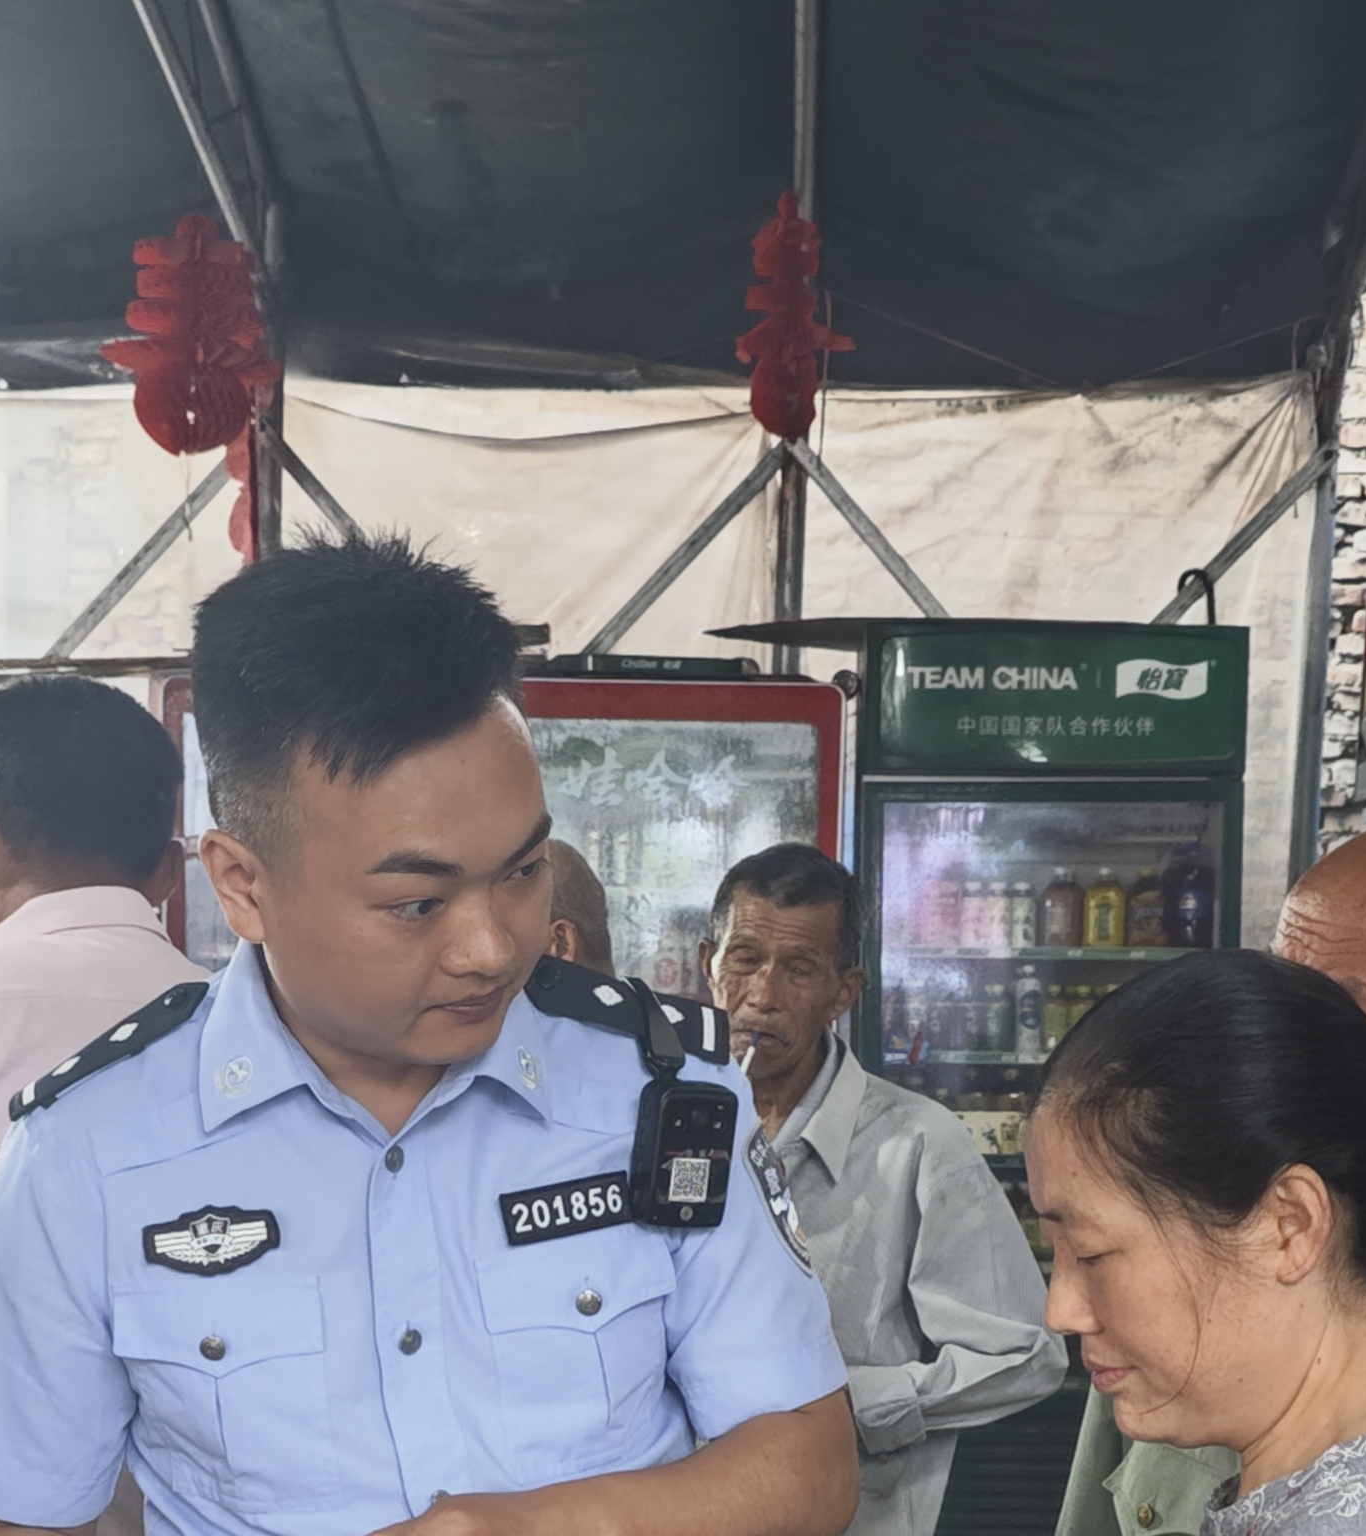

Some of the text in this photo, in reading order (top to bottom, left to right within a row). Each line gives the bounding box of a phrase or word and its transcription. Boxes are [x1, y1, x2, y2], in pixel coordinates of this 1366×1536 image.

[909, 666, 1078, 690] TEAM CHINA
[957, 715, 1156, 738] 中国国家队合作伙伴
[511, 1184, 623, 1233] 201856
